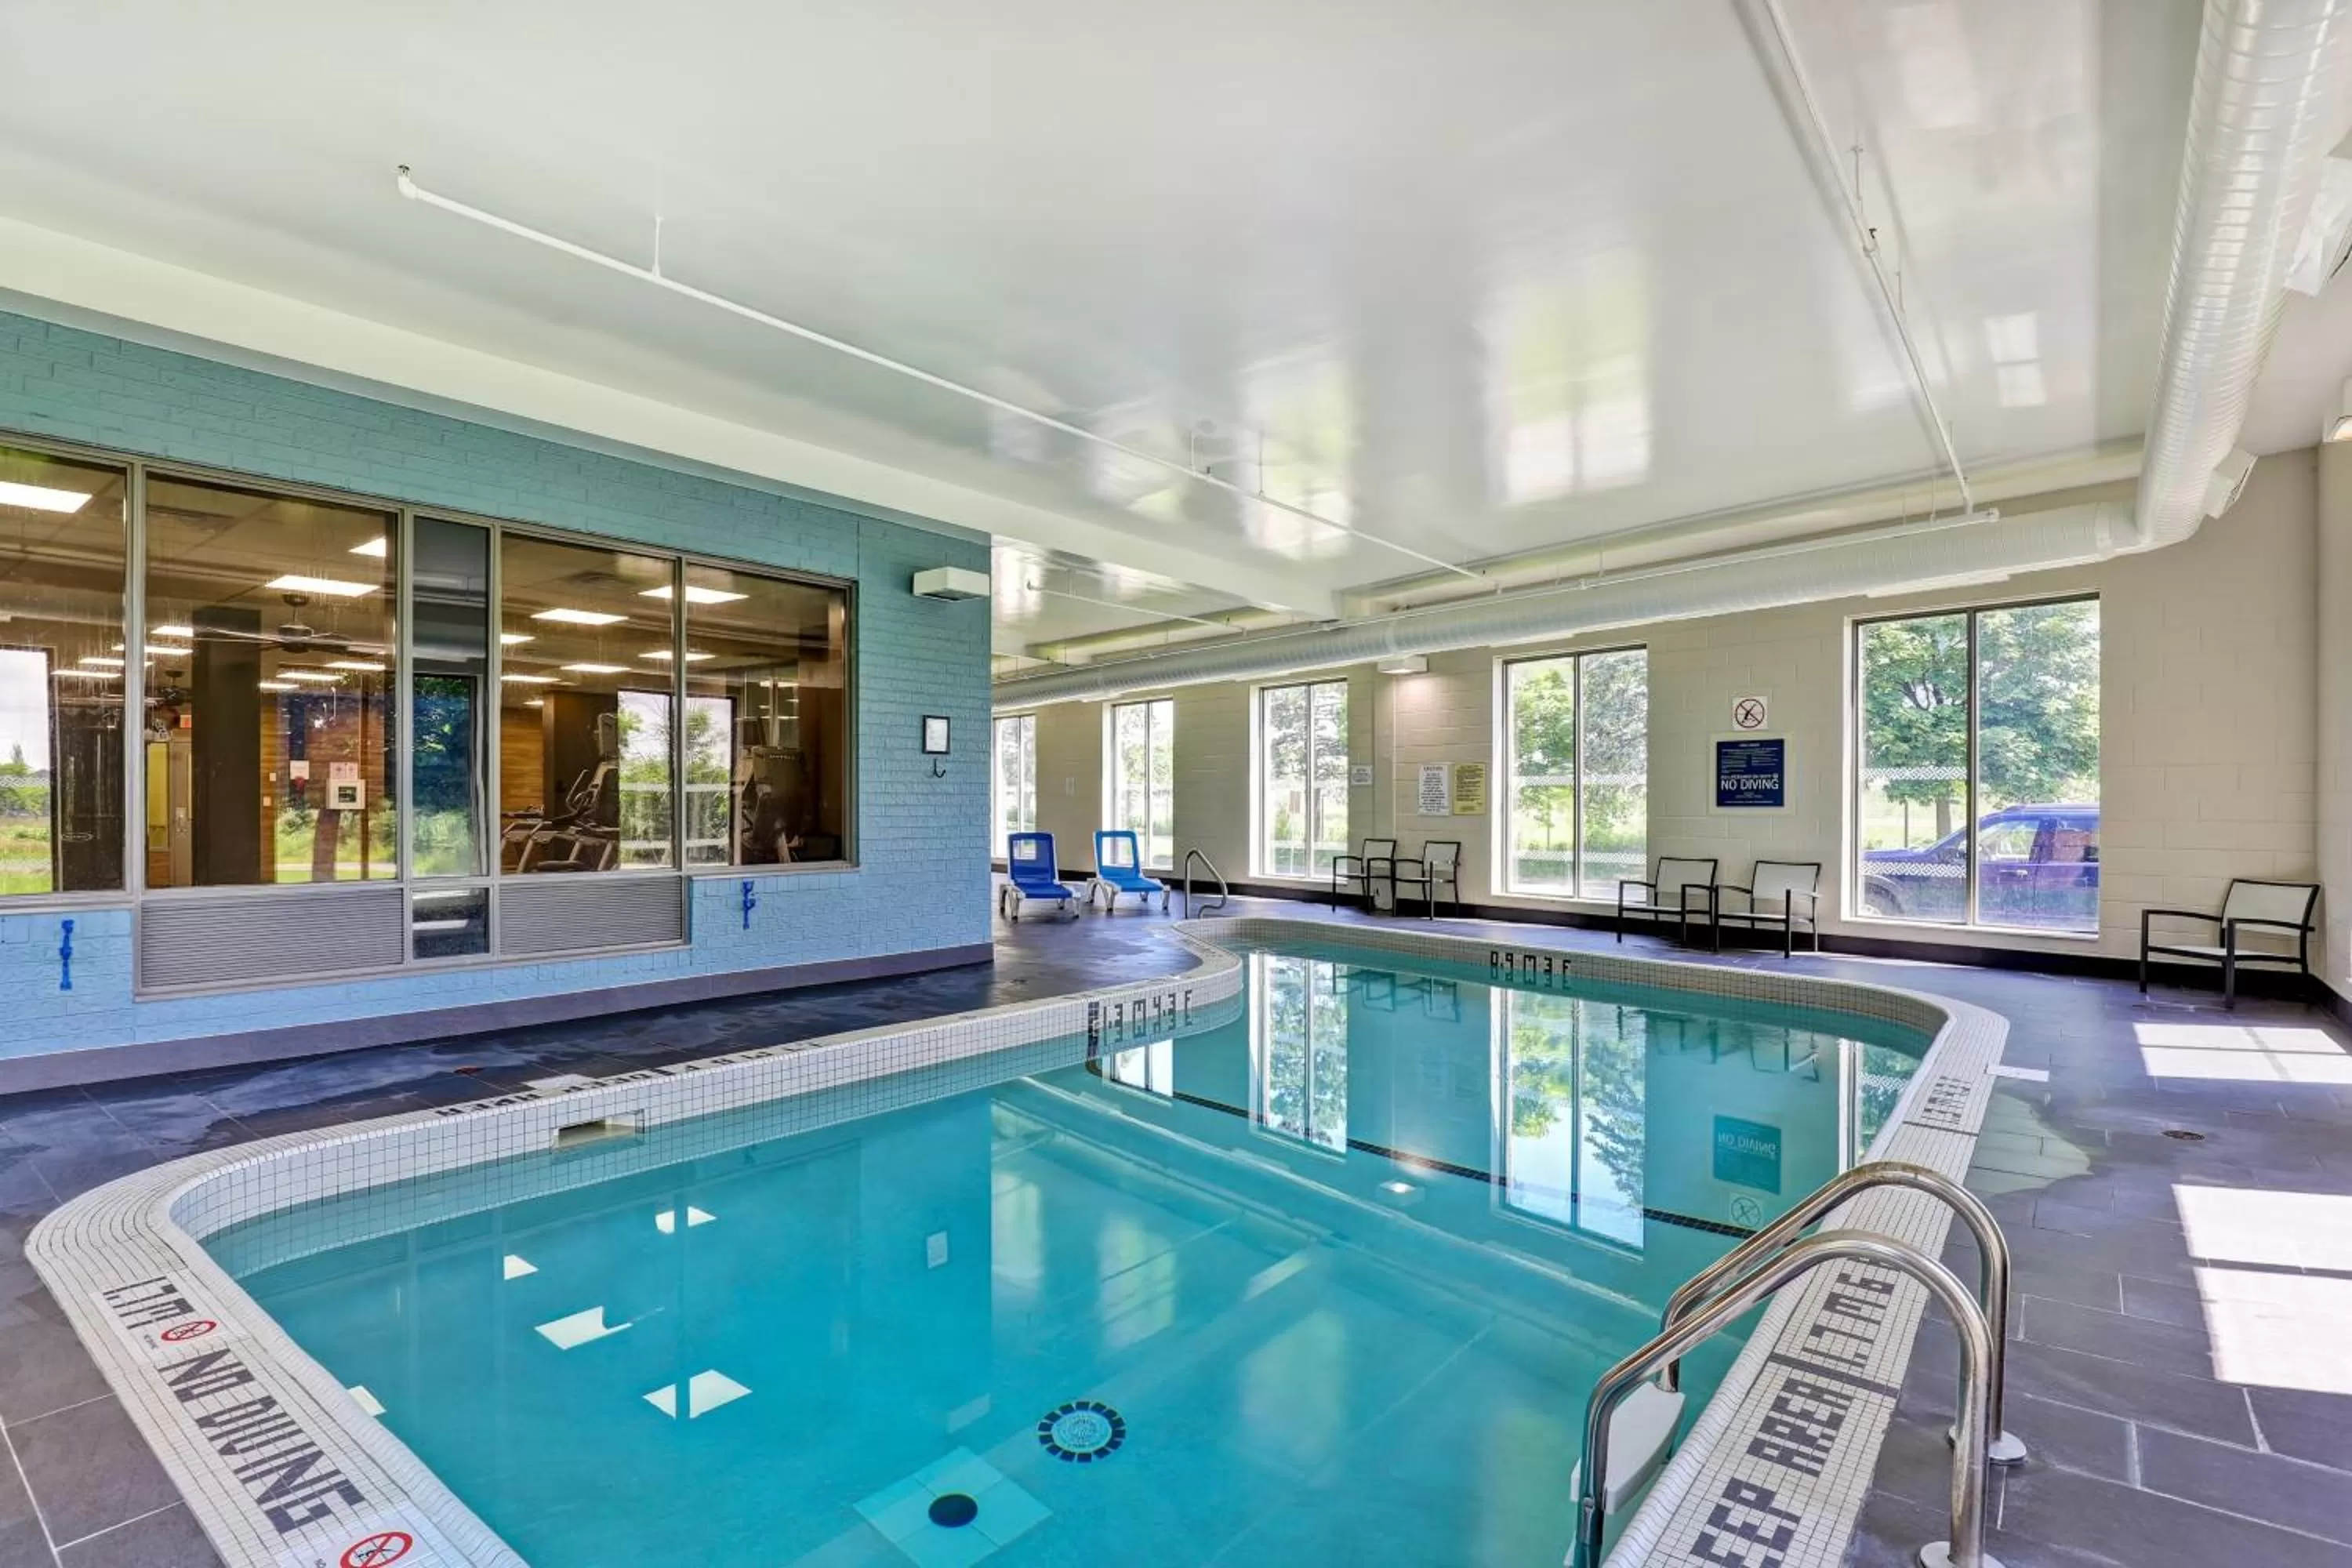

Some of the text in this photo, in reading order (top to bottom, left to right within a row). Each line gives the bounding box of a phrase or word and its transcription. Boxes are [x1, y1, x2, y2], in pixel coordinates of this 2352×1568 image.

[1721, 779, 1779, 790] NO DIVING
[158, 1348, 367, 1534] NO DIVING
[1746, 1377, 1854, 1478] AREA
